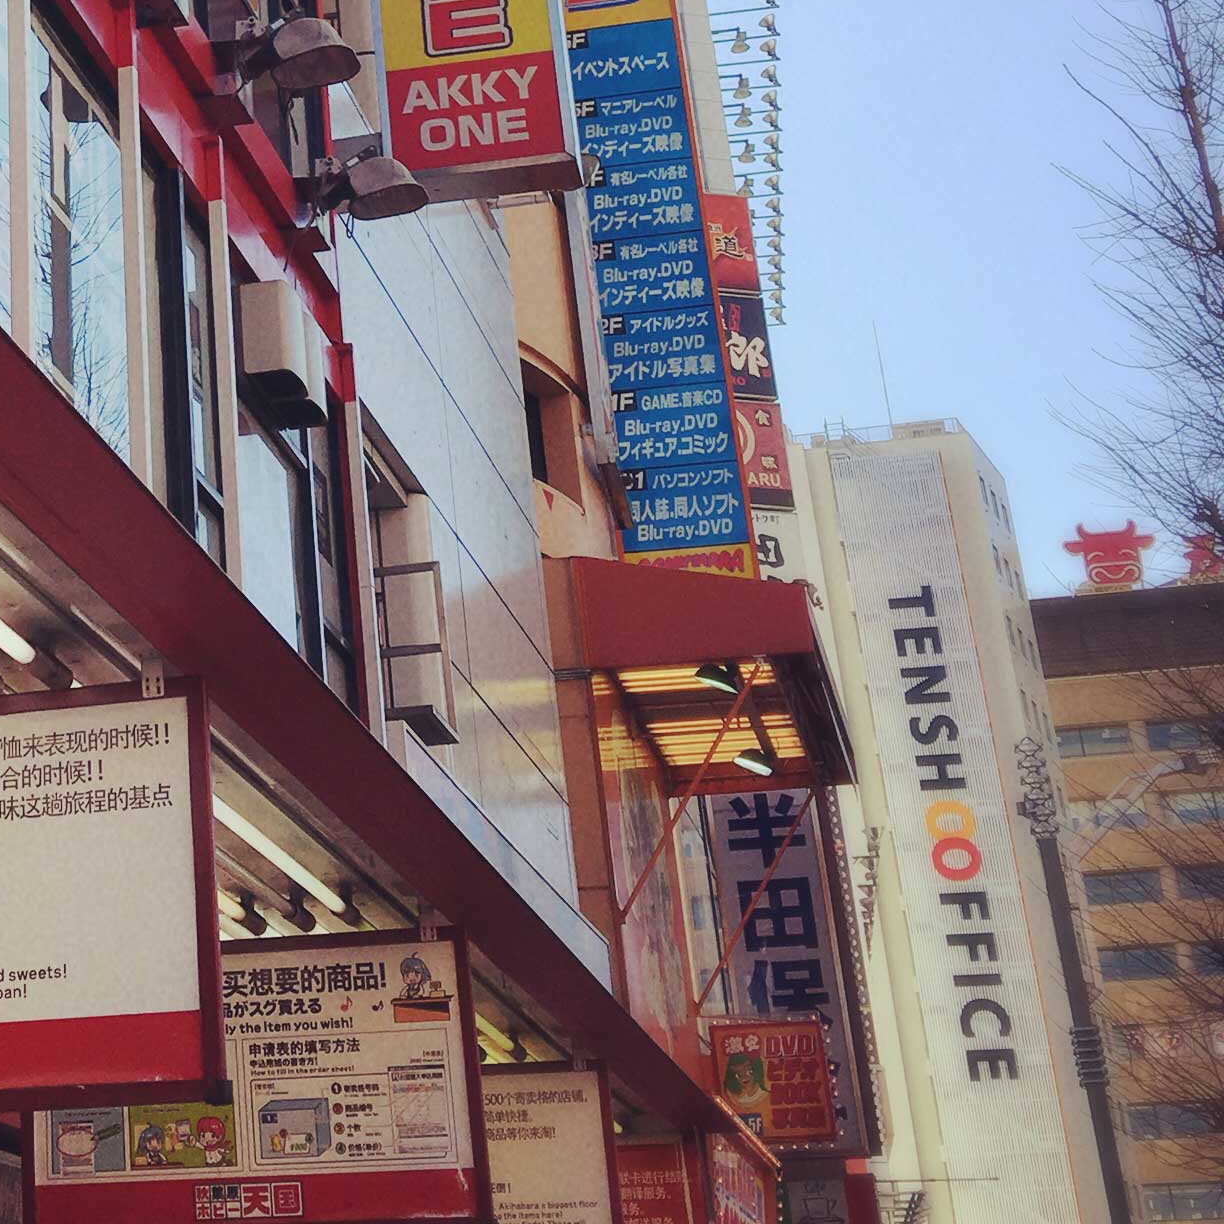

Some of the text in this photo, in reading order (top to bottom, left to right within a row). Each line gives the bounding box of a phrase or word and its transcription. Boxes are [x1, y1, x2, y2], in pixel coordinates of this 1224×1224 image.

[572, 51, 671, 81] イベントスペース
[402, 65, 539, 114] AKKY
[600, 93, 678, 117] マニアレーベル
[420, 107, 530, 152] ONE
[601, 317, 624, 335] 2F
[629, 311, 710, 335] アイドルグッズ
[608, 354, 716, 384] アイドル写真集
[652, 468, 734, 490] パソコンソフト
[886, 585, 975, 842] TENSHO
[931, 836, 1019, 1083] OFFICE
[8, 963, 67, 982] sweets!
[240, 1022, 261, 1034] the
[264, 1019, 291, 1033] item
[294, 1021, 318, 1033] you
[321, 1017, 354, 1030] wish!
[764, 1034, 815, 1058] DVD
[310, 1066, 329, 1074] order
